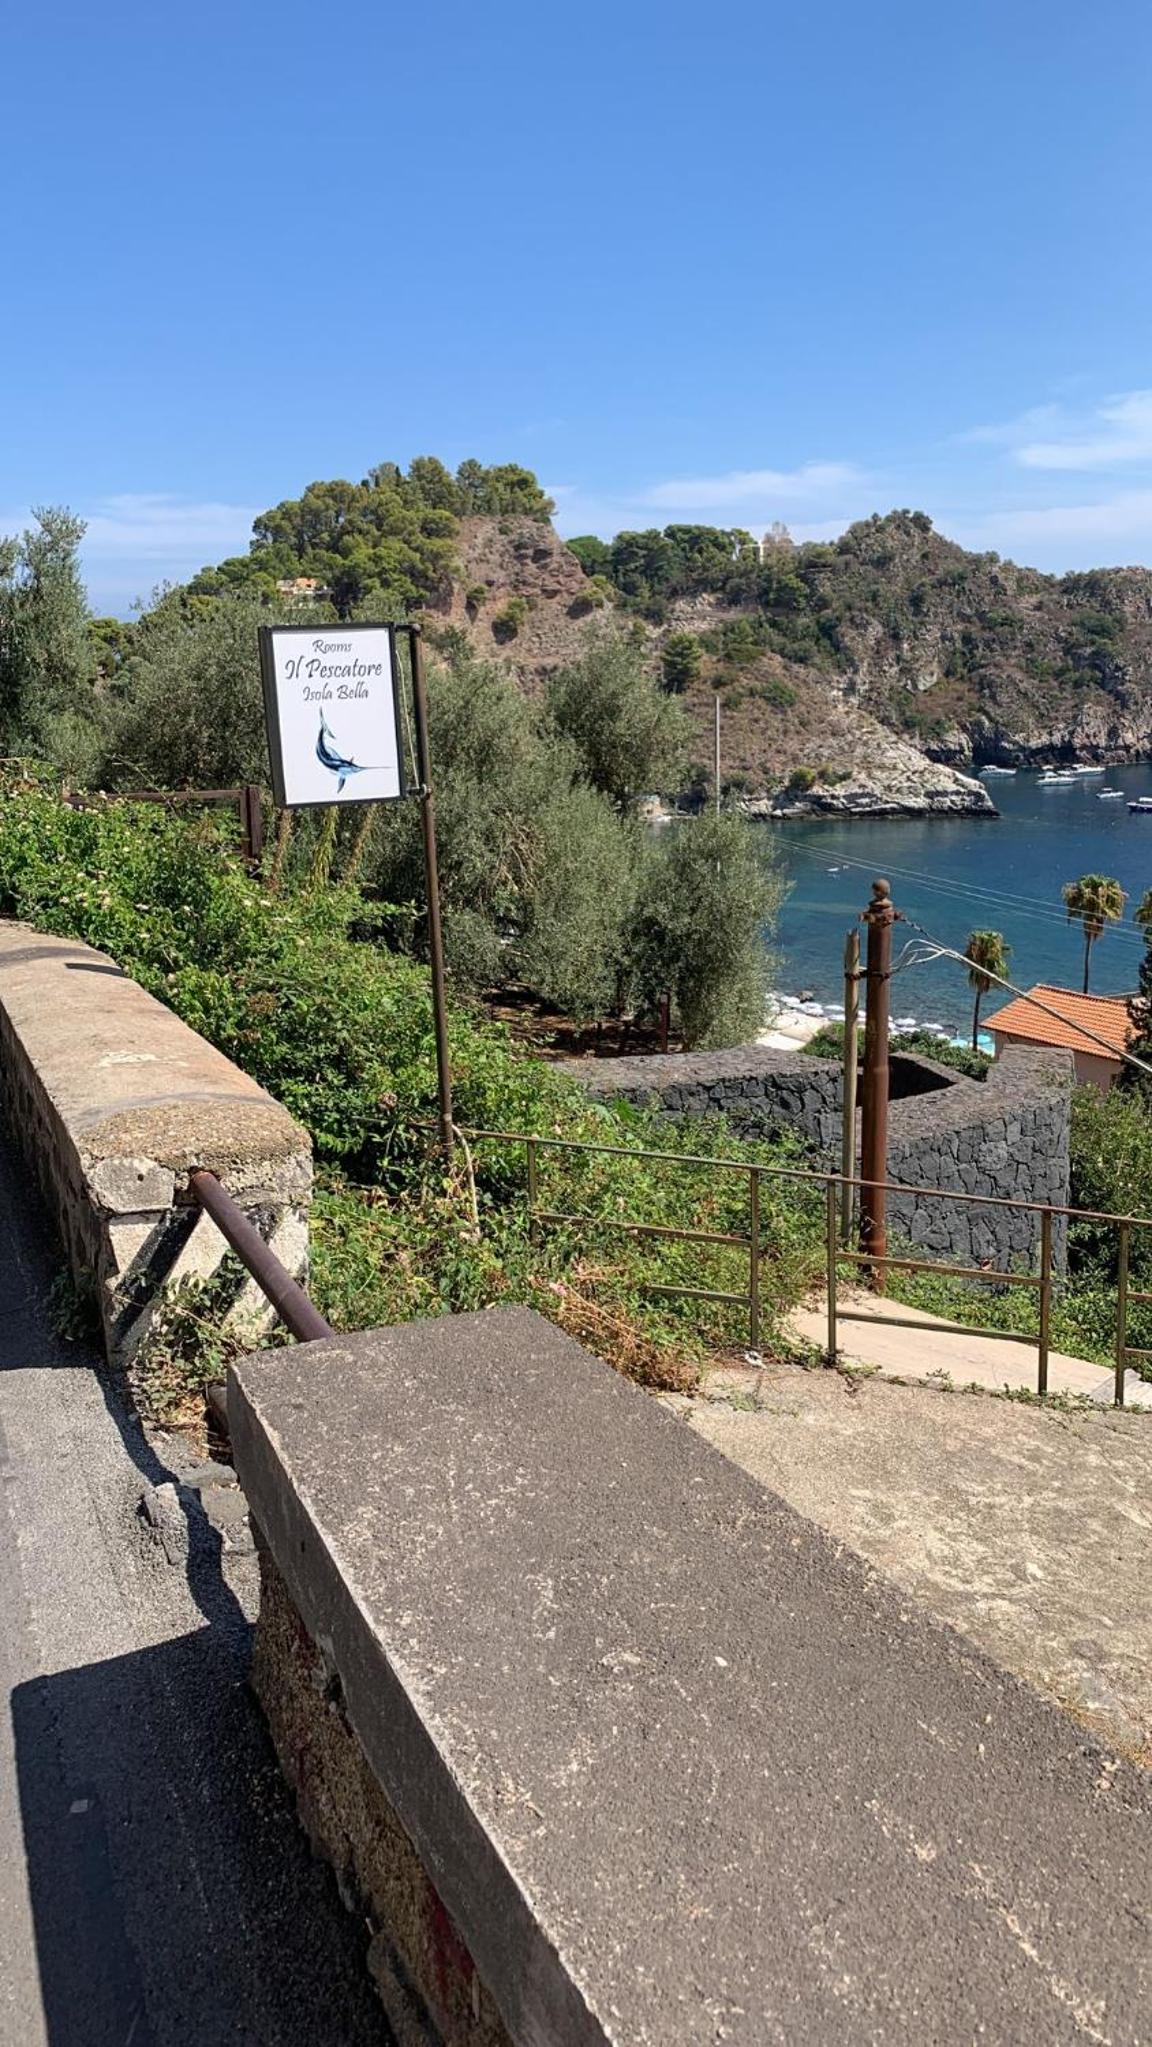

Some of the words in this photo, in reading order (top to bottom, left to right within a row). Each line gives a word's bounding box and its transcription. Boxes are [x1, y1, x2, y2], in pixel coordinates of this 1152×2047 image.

[312, 639, 352, 654] Rooms
[285, 655, 304, 680] Il
[305, 658, 382, 678] Pescatore
[302, 682, 332, 701] Isola
[337, 680, 369, 700] Bella
